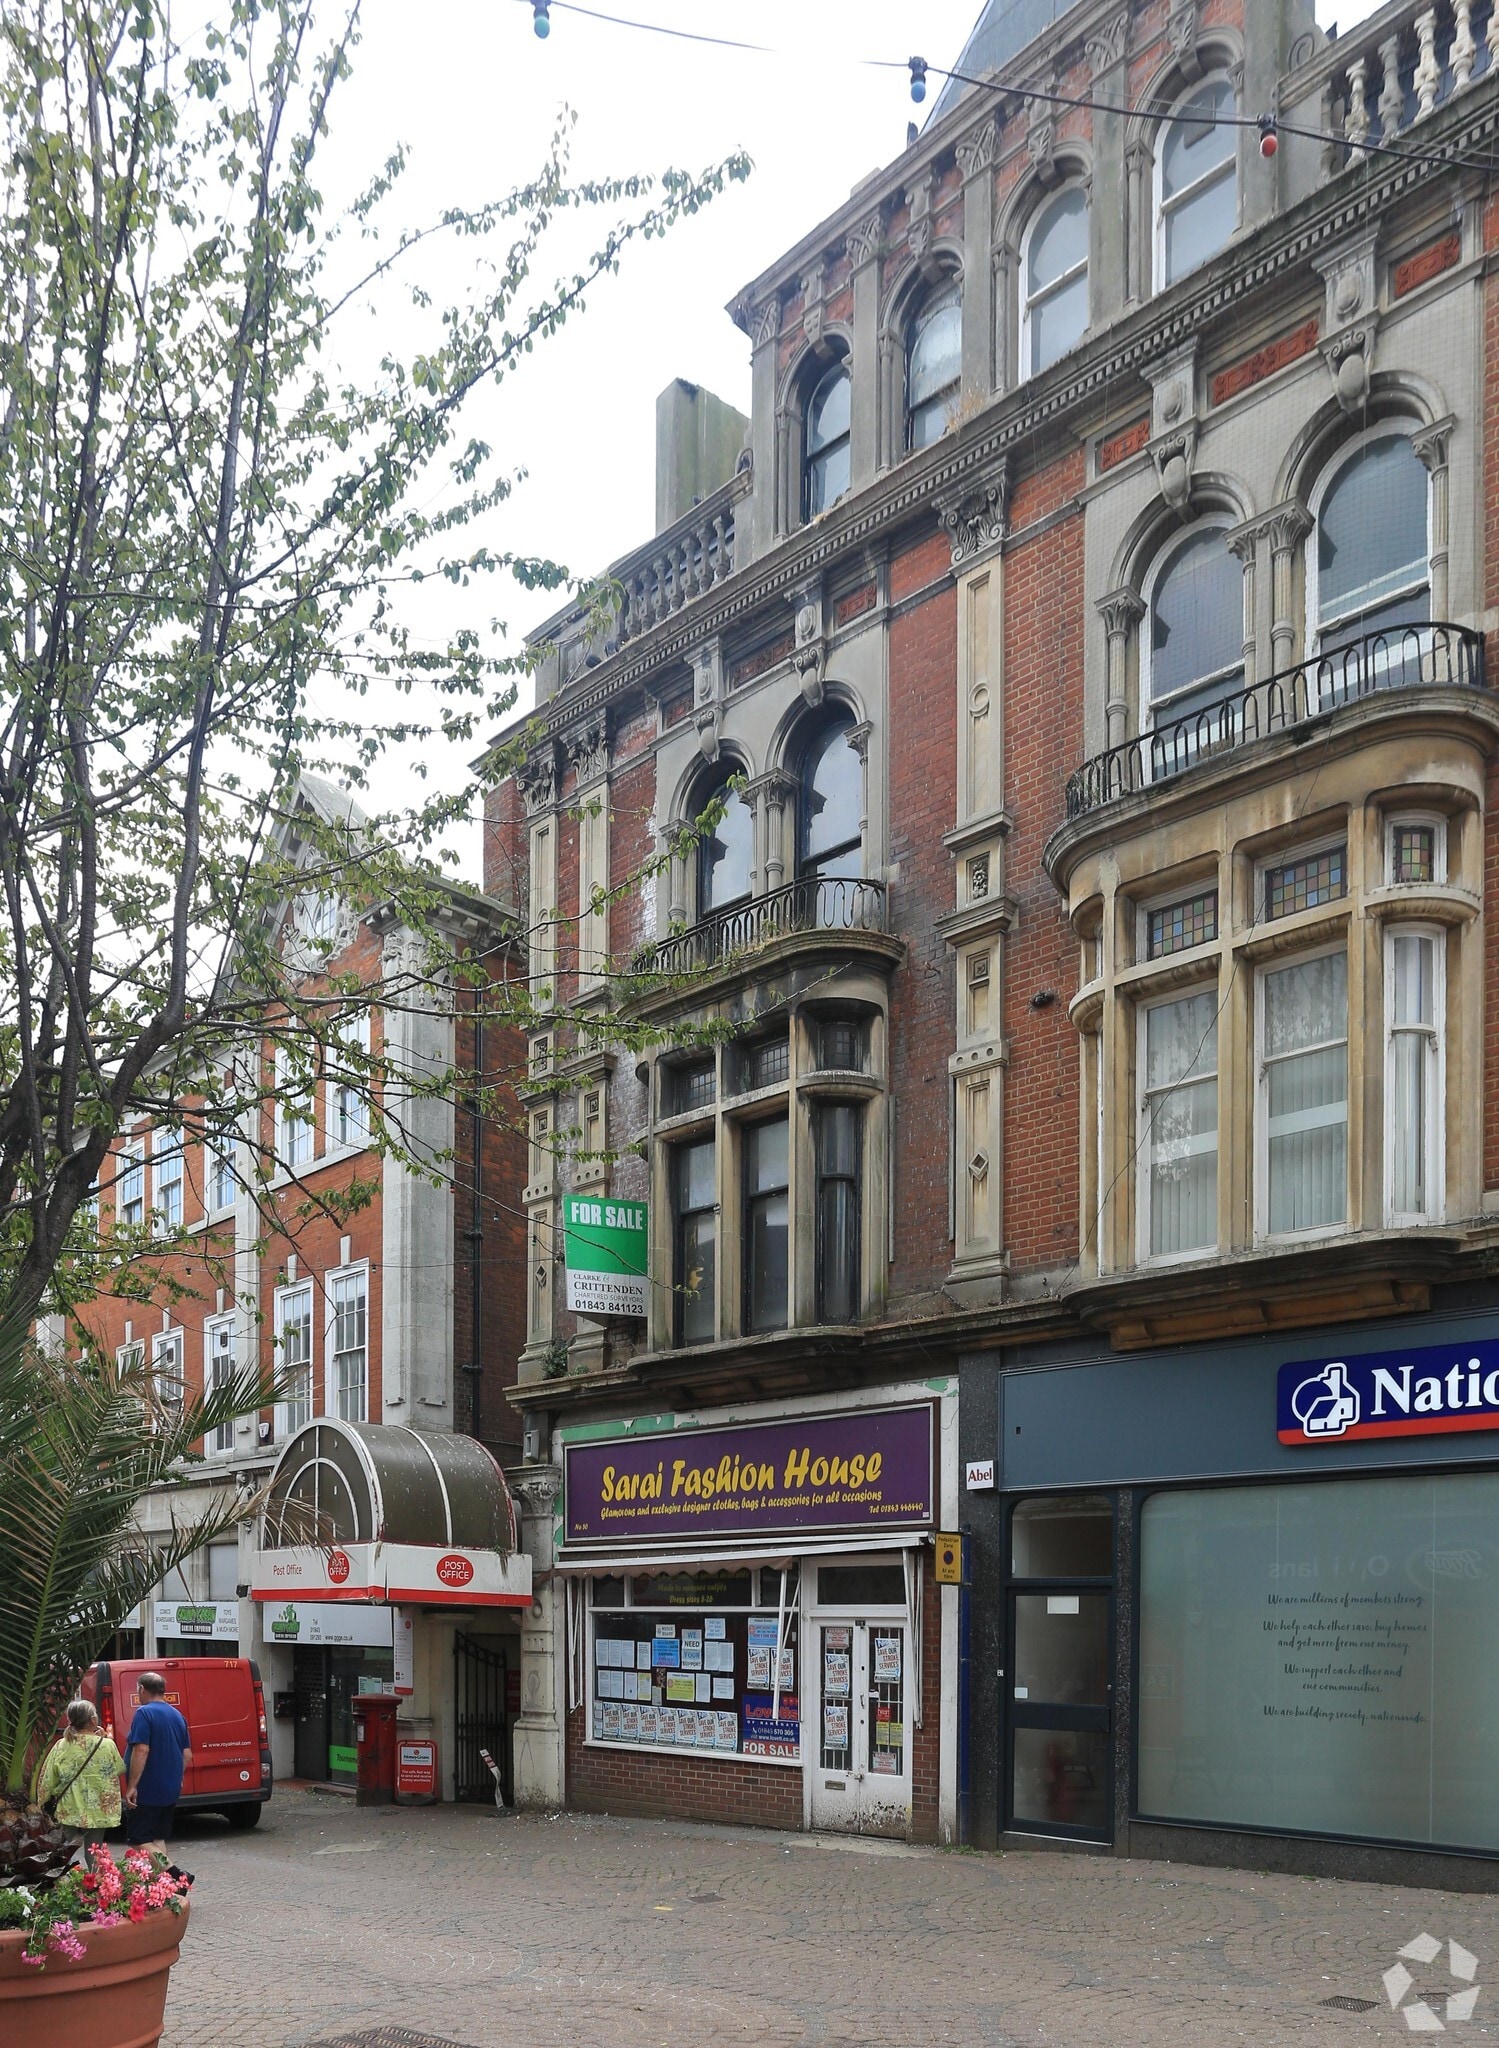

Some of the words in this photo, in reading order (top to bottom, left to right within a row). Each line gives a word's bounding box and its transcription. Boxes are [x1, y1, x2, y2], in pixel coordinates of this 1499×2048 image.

[571, 1202, 601, 1226] FOR
[606, 1206, 643, 1230] SALE
[574, 1282, 642, 1295] CRITTENDEN
[575, 1292, 608, 1300] CHARTERED
[610, 1295, 643, 1303] SURVEYORS
[576, 1300, 605, 1310] 01843
[609, 1302, 643, 1314] 841123
[601, 1462, 663, 1502] Sarai
[671, 1454, 774, 1499] Fashion
[784, 1448, 882, 1489] House
[968, 1467, 992, 1482] Abel
[637, 1504, 650, 1515] and
[651, 1503, 680, 1514] exclusive
[682, 1501, 710, 1513] designer
[713, 1498, 740, 1511] clothes,
[742, 1497, 759, 1511] bags
[761, 1496, 766, 1507] &
[768, 1494, 810, 1507] accessories
[812, 1492, 823, 1507] for
[826, 1491, 839, 1503] all
[842, 1489, 882, 1502] occasions
[273, 1565, 285, 1575] Post
[287, 1564, 302, 1575] Office
[330, 1567, 347, 1576] OFFICE
[445, 1561, 466, 1570] POST
[440, 1570, 469, 1580] OFFICE
[1268, 1593, 1284, 1605] We
[1285, 1595, 1299, 1604] are
[1301, 1592, 1338, 1604] millions
[1340, 1592, 1349, 1607] of
[1351, 1592, 1391, 1604] members
[1263, 1620, 1278, 1631] We
[1280, 1619, 1300, 1635] help
[1302, 1620, 1325, 1631] each
[1327, 1620, 1349, 1631] other
[1375, 1621, 1391, 1638] buy
[1394, 1620, 1427, 1632] homes
[1278, 1636, 1295, 1648] and
[1297, 1637, 1311, 1650] get
[1335, 1637, 1357, 1651] from
[1284, 1664, 1299, 1674] We
[1302, 1664, 1331, 1678] support
[1333, 1664, 1357, 1675] each
[1358, 1664, 1381, 1675] other
[1384, 1664, 1402, 1677] and
[746, 1704, 798, 1720] Lovtts
[1264, 1705, 1278, 1716] We
[1281, 1708, 1293, 1716] are
[1295, 1706, 1333, 1721] building
[208, 1740, 251, 1748] www.royalmail.com
[743, 1741, 766, 1754] FOR
[770, 1744, 799, 1756] SALE
